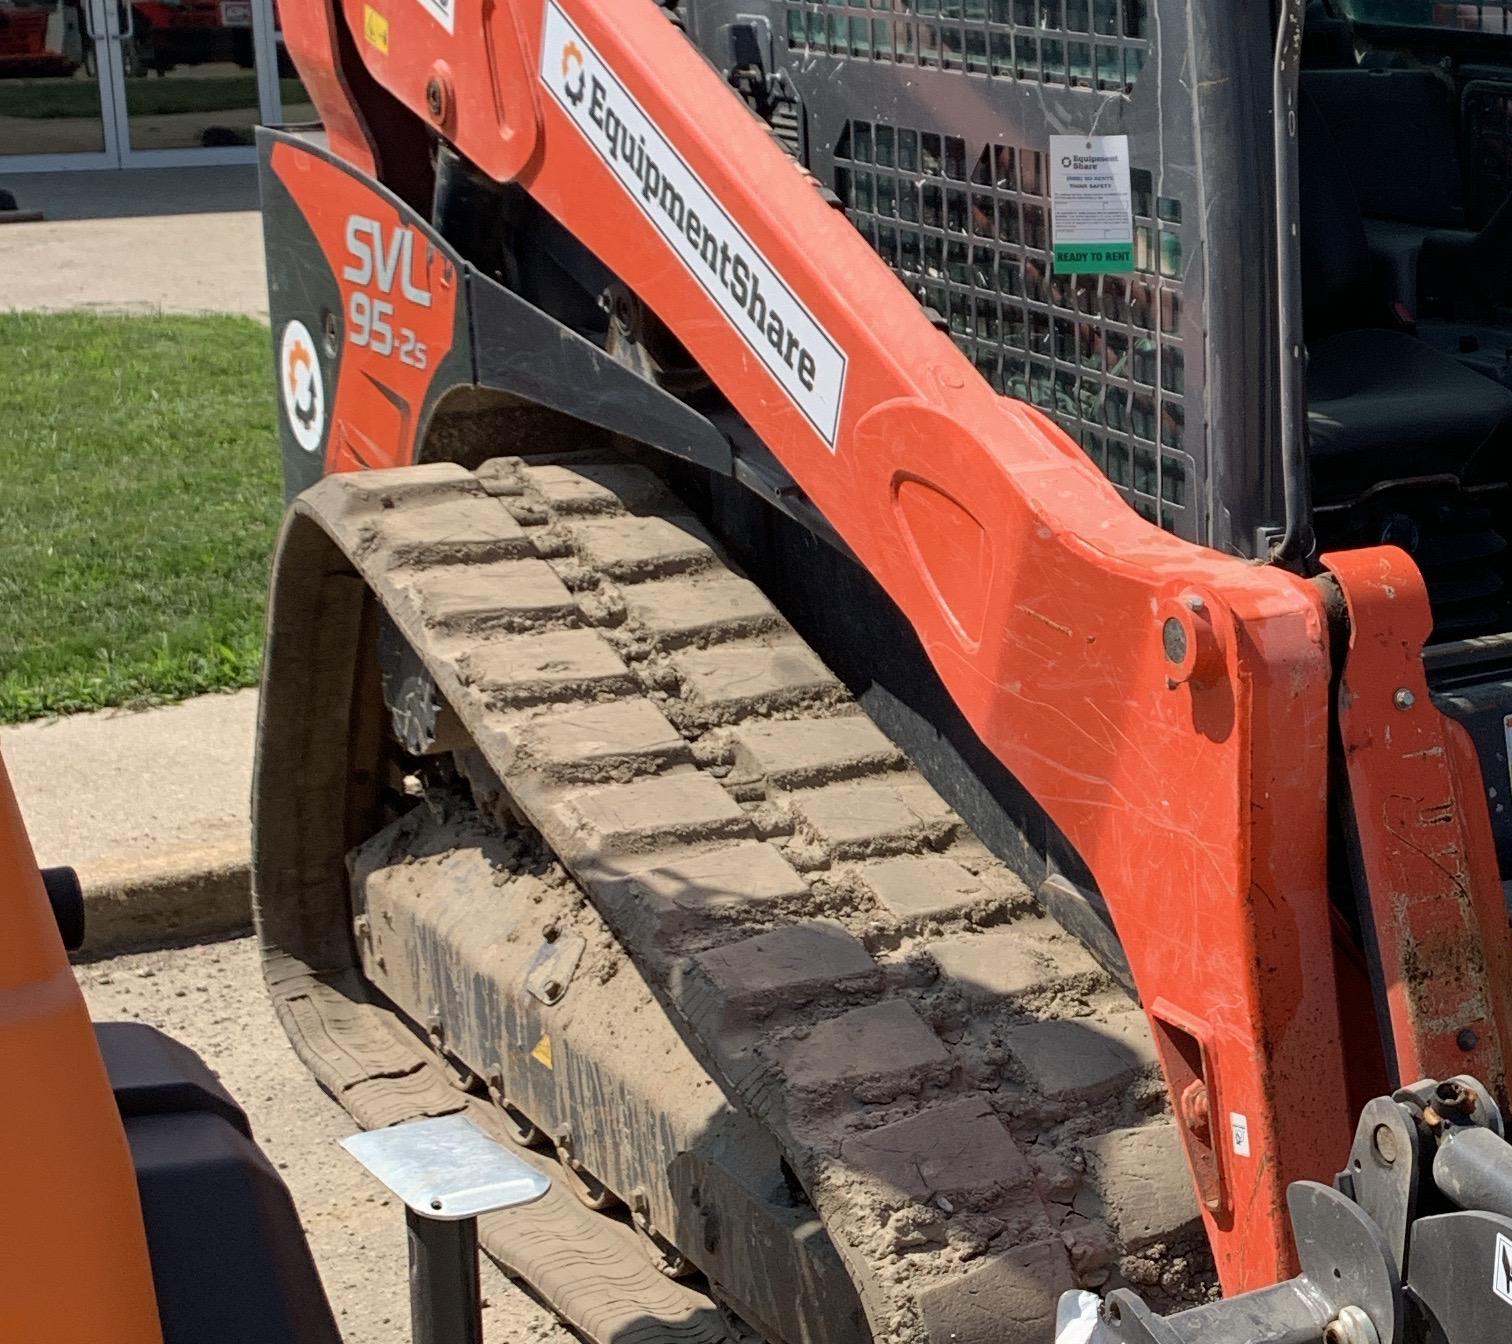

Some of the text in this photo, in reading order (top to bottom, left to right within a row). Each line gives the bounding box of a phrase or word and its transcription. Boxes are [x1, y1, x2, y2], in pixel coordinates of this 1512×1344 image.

[343, 214, 432, 307] SVL
[587, 73, 817, 392] EquipmentShare
[1057, 251, 1131, 262] READY TO RENT
